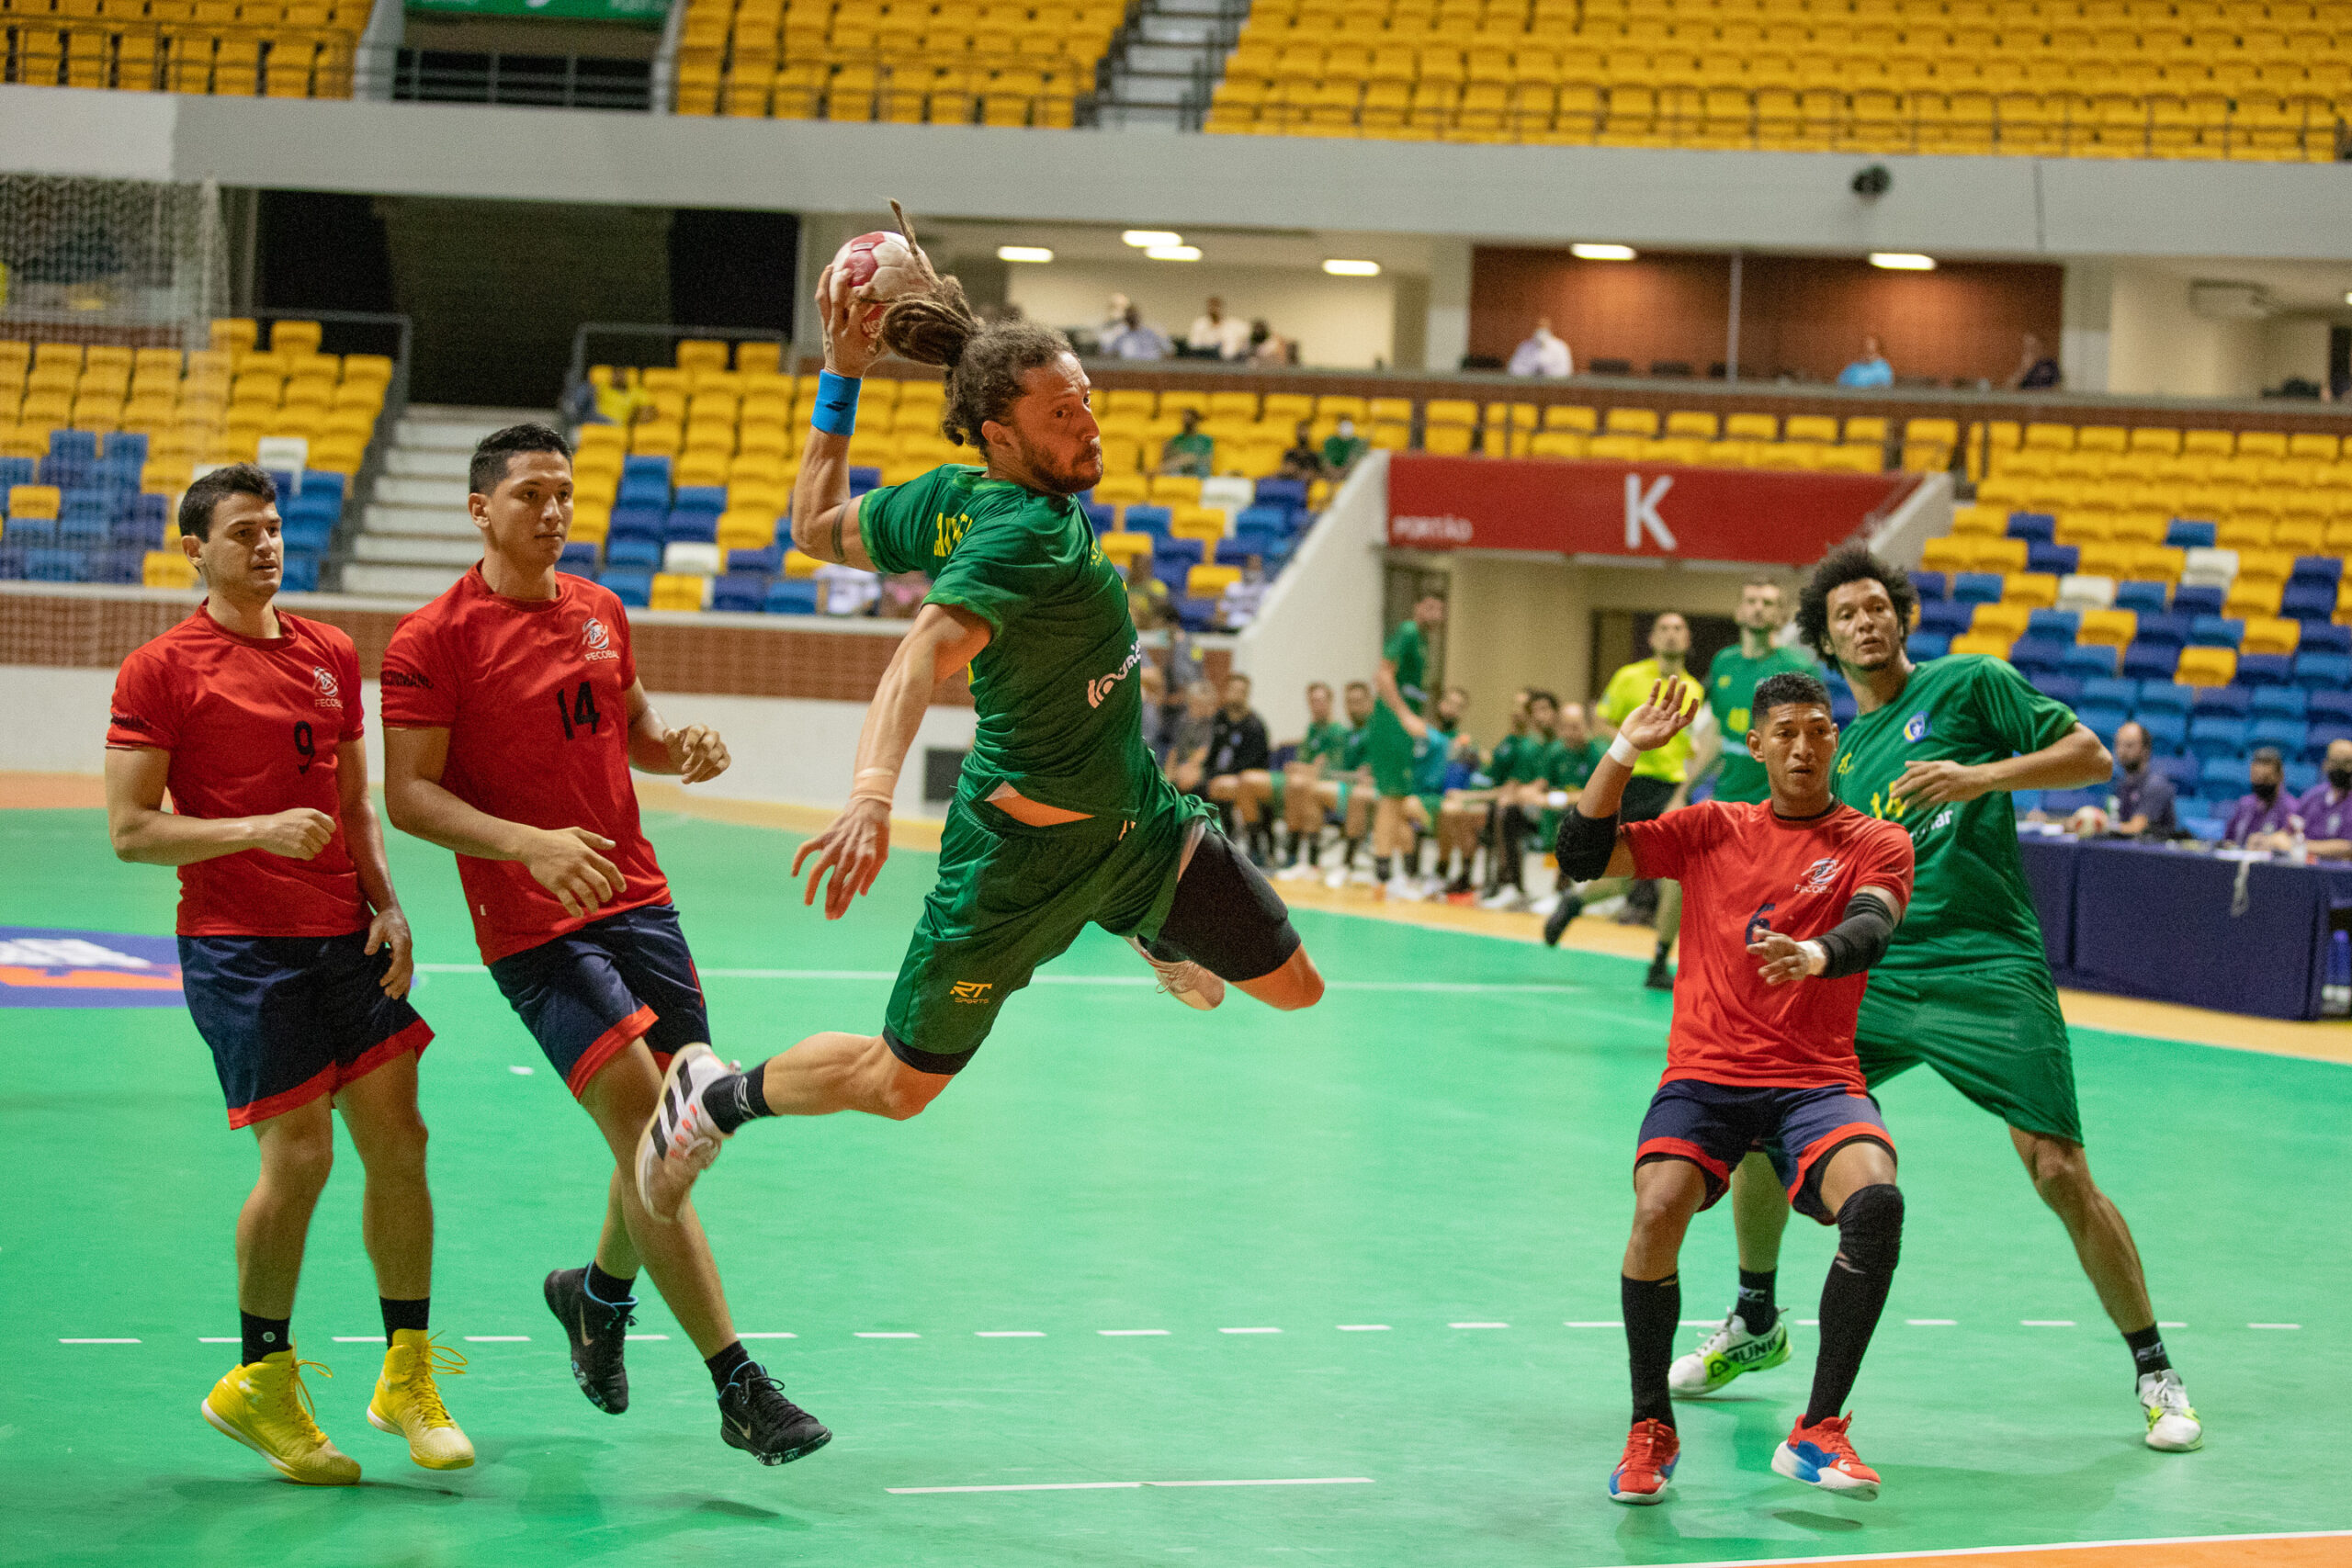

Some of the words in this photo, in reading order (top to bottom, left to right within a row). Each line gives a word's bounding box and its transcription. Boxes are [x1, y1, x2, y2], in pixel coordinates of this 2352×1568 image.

[1625, 473, 1678, 550] K
[557, 681, 600, 740] 14
[294, 721, 314, 774] 9
[1746, 903, 1775, 945] 6
[949, 980, 993, 998] RT
